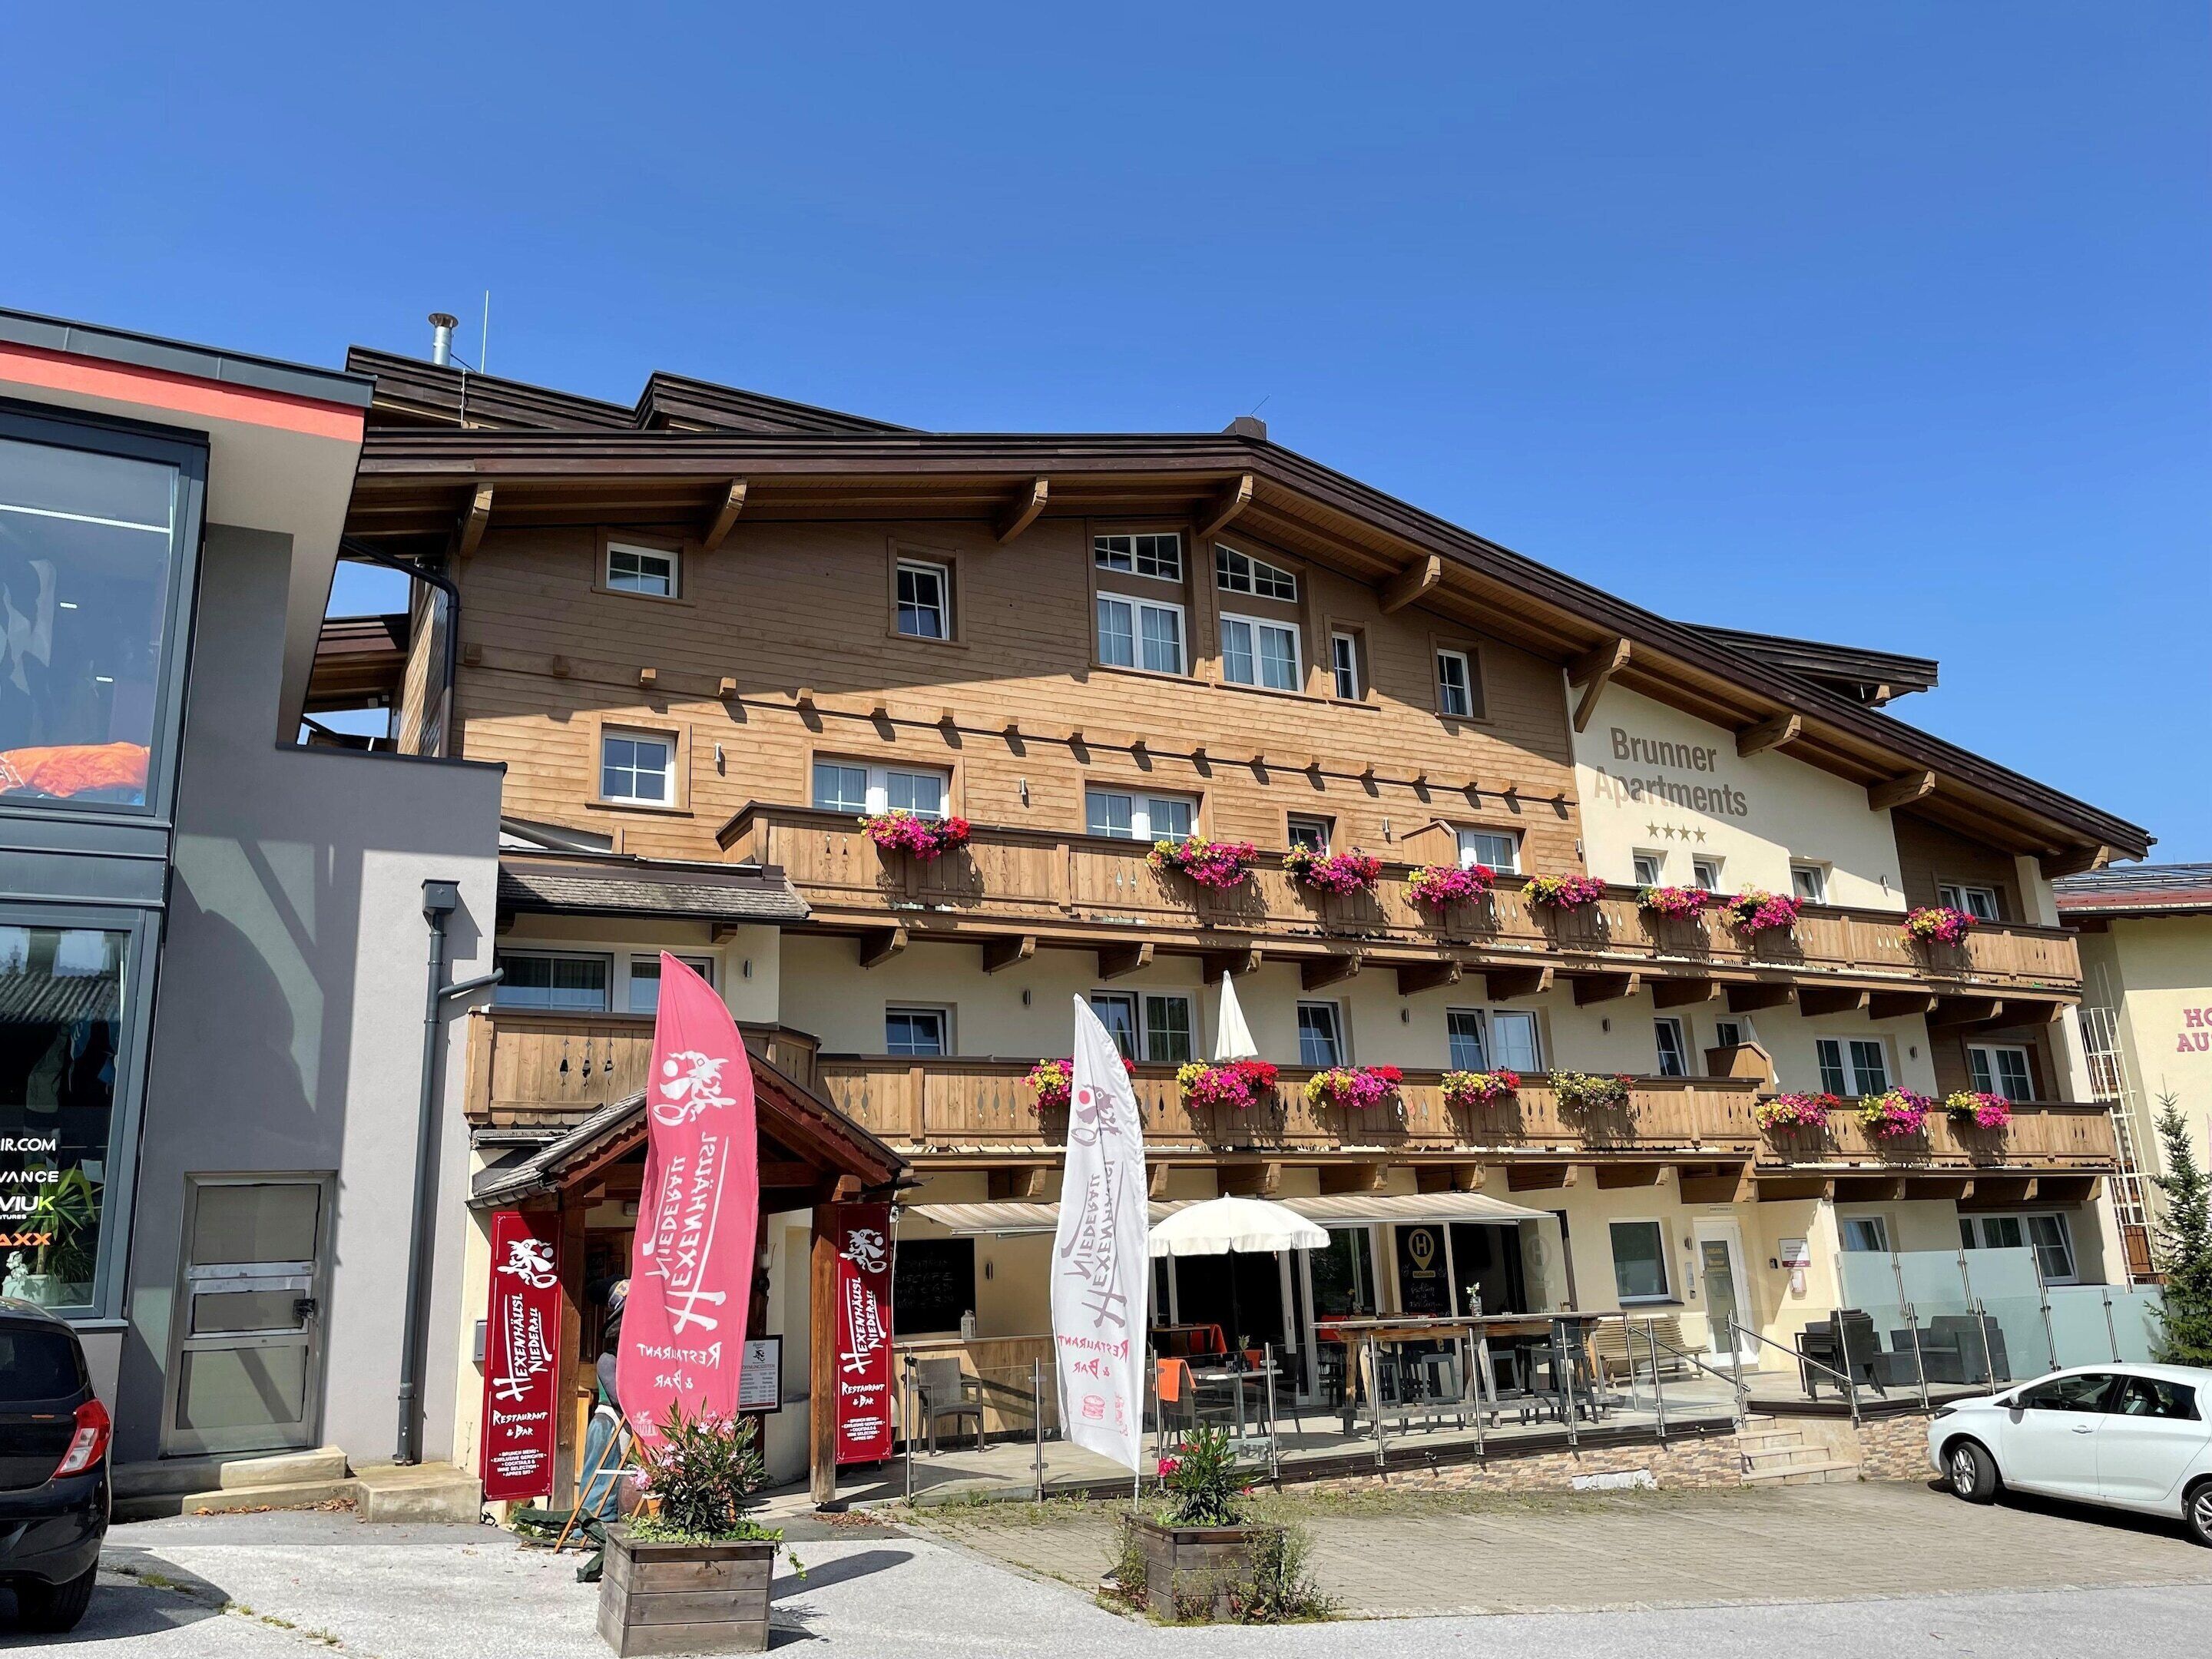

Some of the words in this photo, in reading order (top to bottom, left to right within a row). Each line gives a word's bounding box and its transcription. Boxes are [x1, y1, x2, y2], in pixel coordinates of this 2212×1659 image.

[1611, 727, 1717, 772] Brunner
[1594, 766, 1747, 816] Apartments
[2177, 1032, 2212, 1051] AU
[0, 1138, 56, 1151] IR.COM
[0, 1232, 51, 1246] AXX
[1416, 1236, 1427, 1255] H
[840, 1277, 873, 1375] HEXENHÄUSL
[866, 1290, 886, 1349] NIEDERAU
[492, 1293, 534, 1402] HEXENHÄUSL
[528, 1307, 552, 1373] NIEDERAU
[842, 1381, 885, 1396] RESTAURANT
[859, 1394, 874, 1408] BAR
[493, 1409, 548, 1426] RESTAURANT
[514, 1424, 534, 1439] BAR
